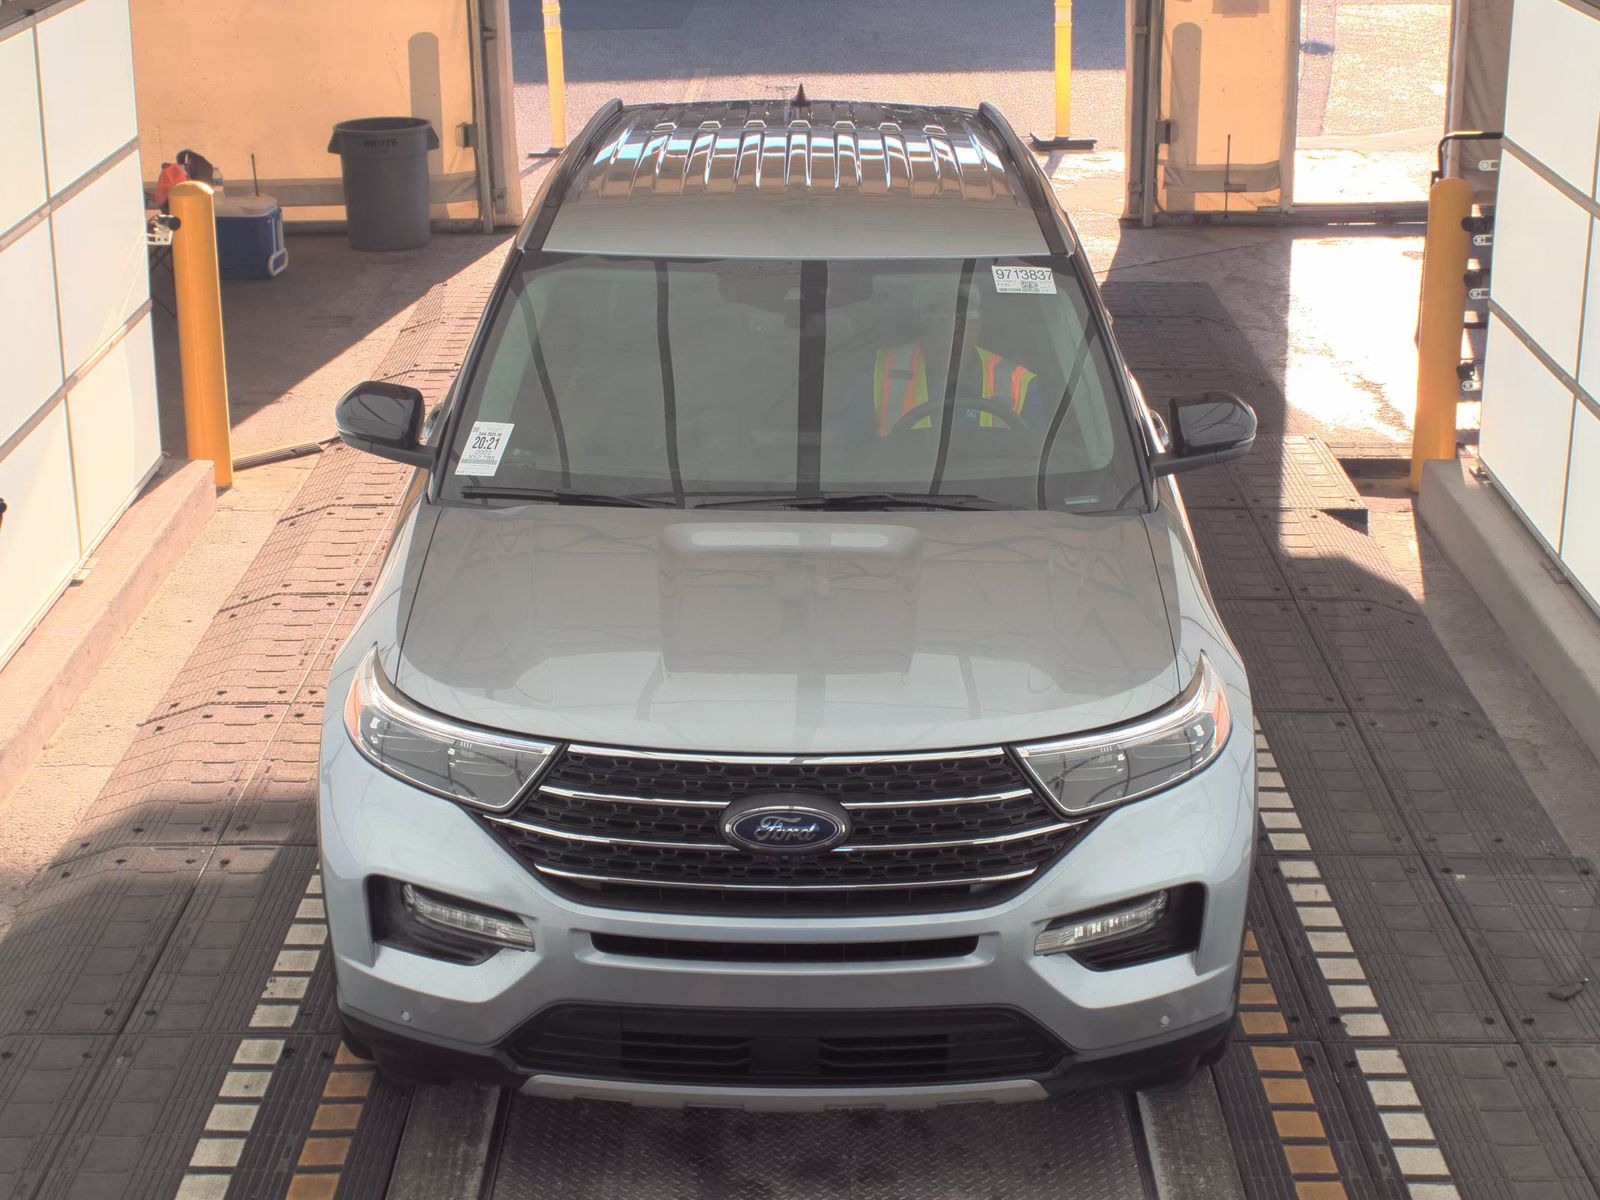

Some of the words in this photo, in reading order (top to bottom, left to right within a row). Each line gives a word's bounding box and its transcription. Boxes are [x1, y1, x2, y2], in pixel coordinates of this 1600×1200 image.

[995, 268, 1052, 281] 9713837
[472, 436, 501, 450] 20:21
[754, 815, 817, 841] Ford
